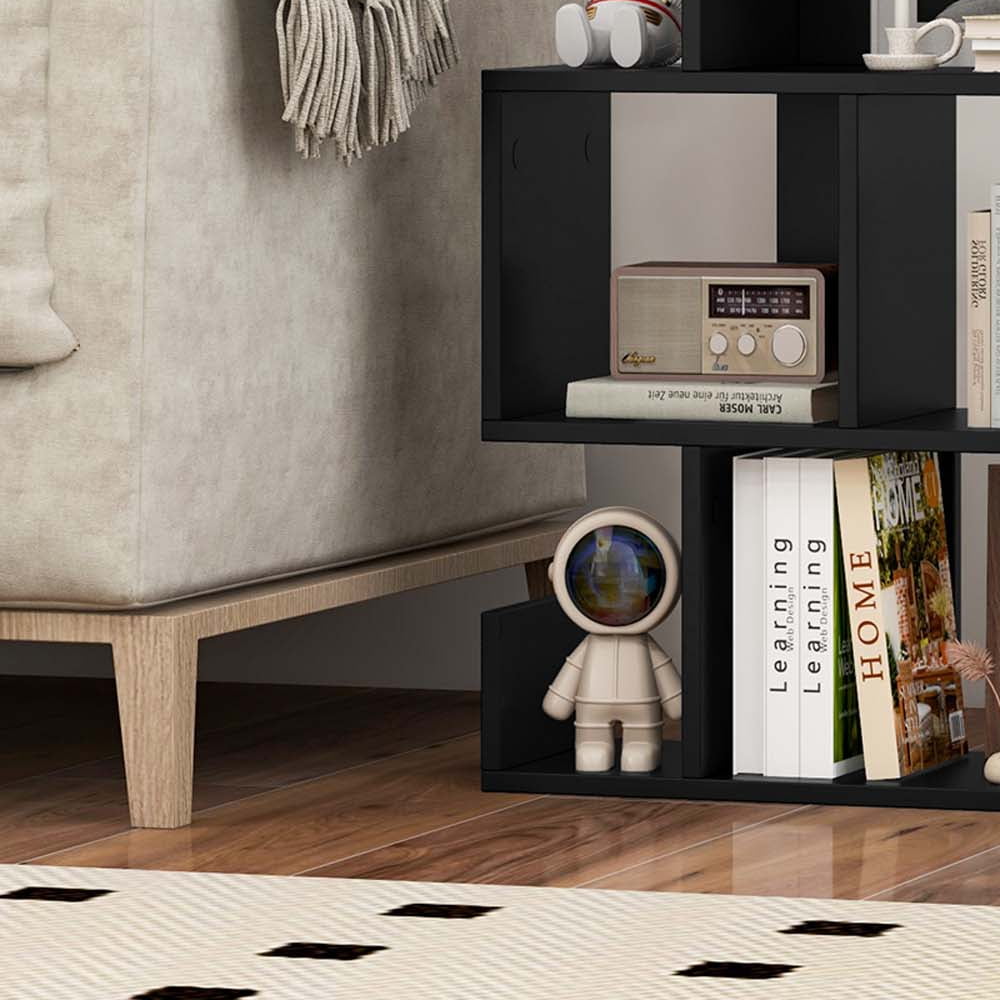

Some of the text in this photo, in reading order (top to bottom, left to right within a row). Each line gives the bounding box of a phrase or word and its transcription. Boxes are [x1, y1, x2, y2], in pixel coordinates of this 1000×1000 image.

[648, 390, 783, 403] Architektur für eine neue Zeit
[719, 402, 782, 414] CARL MOSER
[769, 537, 793, 692] Learning
[785, 586, 796, 652] Web Design
[803, 538, 827, 693] Learning
[820, 587, 830, 653] Web Design
[849, 550, 884, 682] HOME
